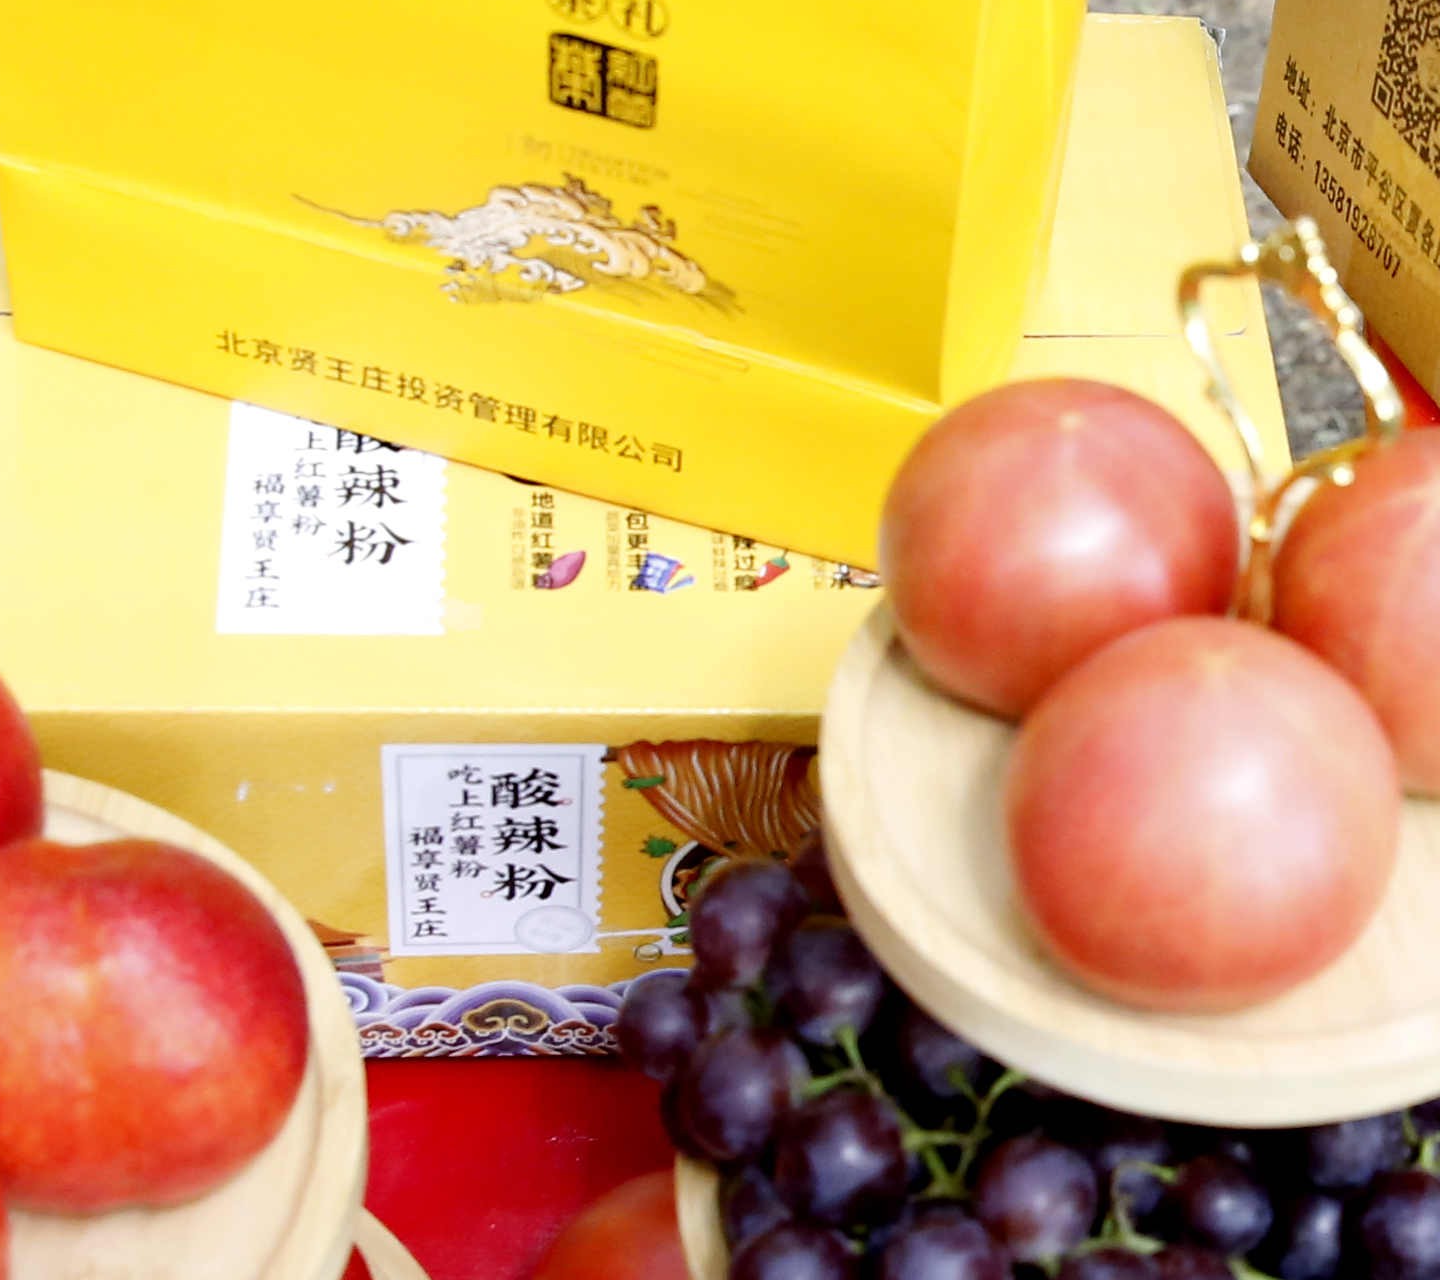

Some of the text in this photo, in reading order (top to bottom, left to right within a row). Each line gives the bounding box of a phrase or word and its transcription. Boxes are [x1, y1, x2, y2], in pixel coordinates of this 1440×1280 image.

[216, 329, 685, 474] 北京贤王庄投资管理有限公司
[244, 472, 286, 609] 福享贤王庄
[292, 420, 328, 536] 上红薯粉
[409, 824, 448, 939] 福享贤王庄
[447, 764, 488, 880] 吃上红薯粉
[491, 768, 577, 902] 酸辣粉
